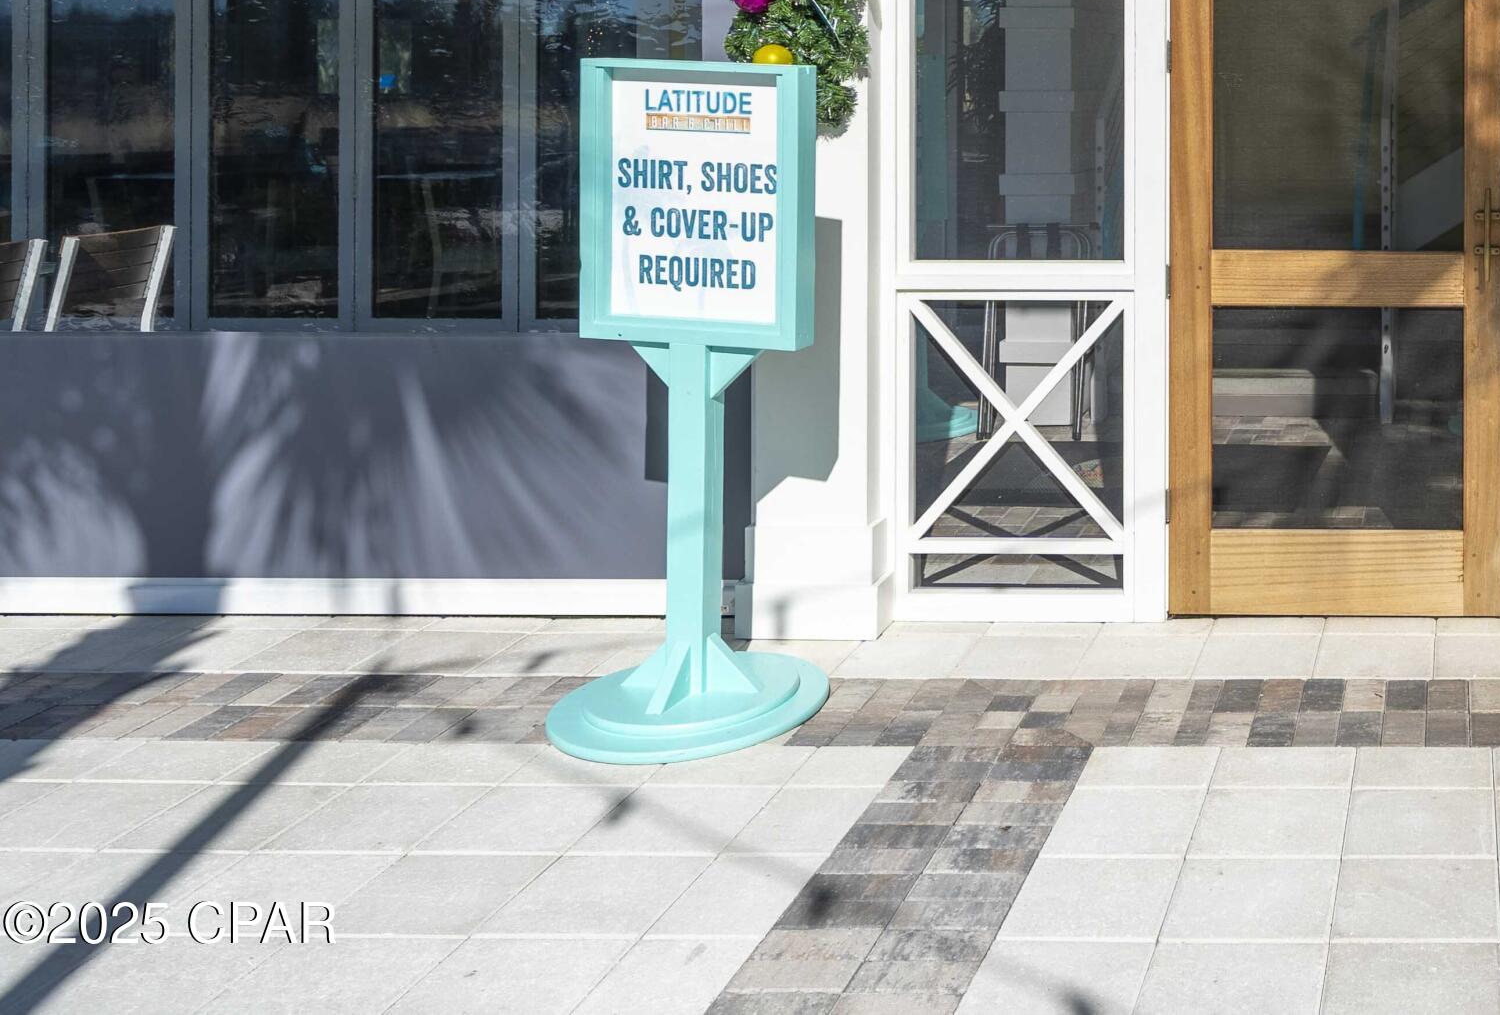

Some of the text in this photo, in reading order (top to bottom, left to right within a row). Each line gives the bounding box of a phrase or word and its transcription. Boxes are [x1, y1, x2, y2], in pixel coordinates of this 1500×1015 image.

[645, 89, 752, 115] LATITUDE
[651, 115, 680, 129] BAR
[617, 157, 777, 194] SHIRT, SHOES
[622, 205, 774, 243] & COVER-UP
[639, 254, 756, 291] REQUIRED
